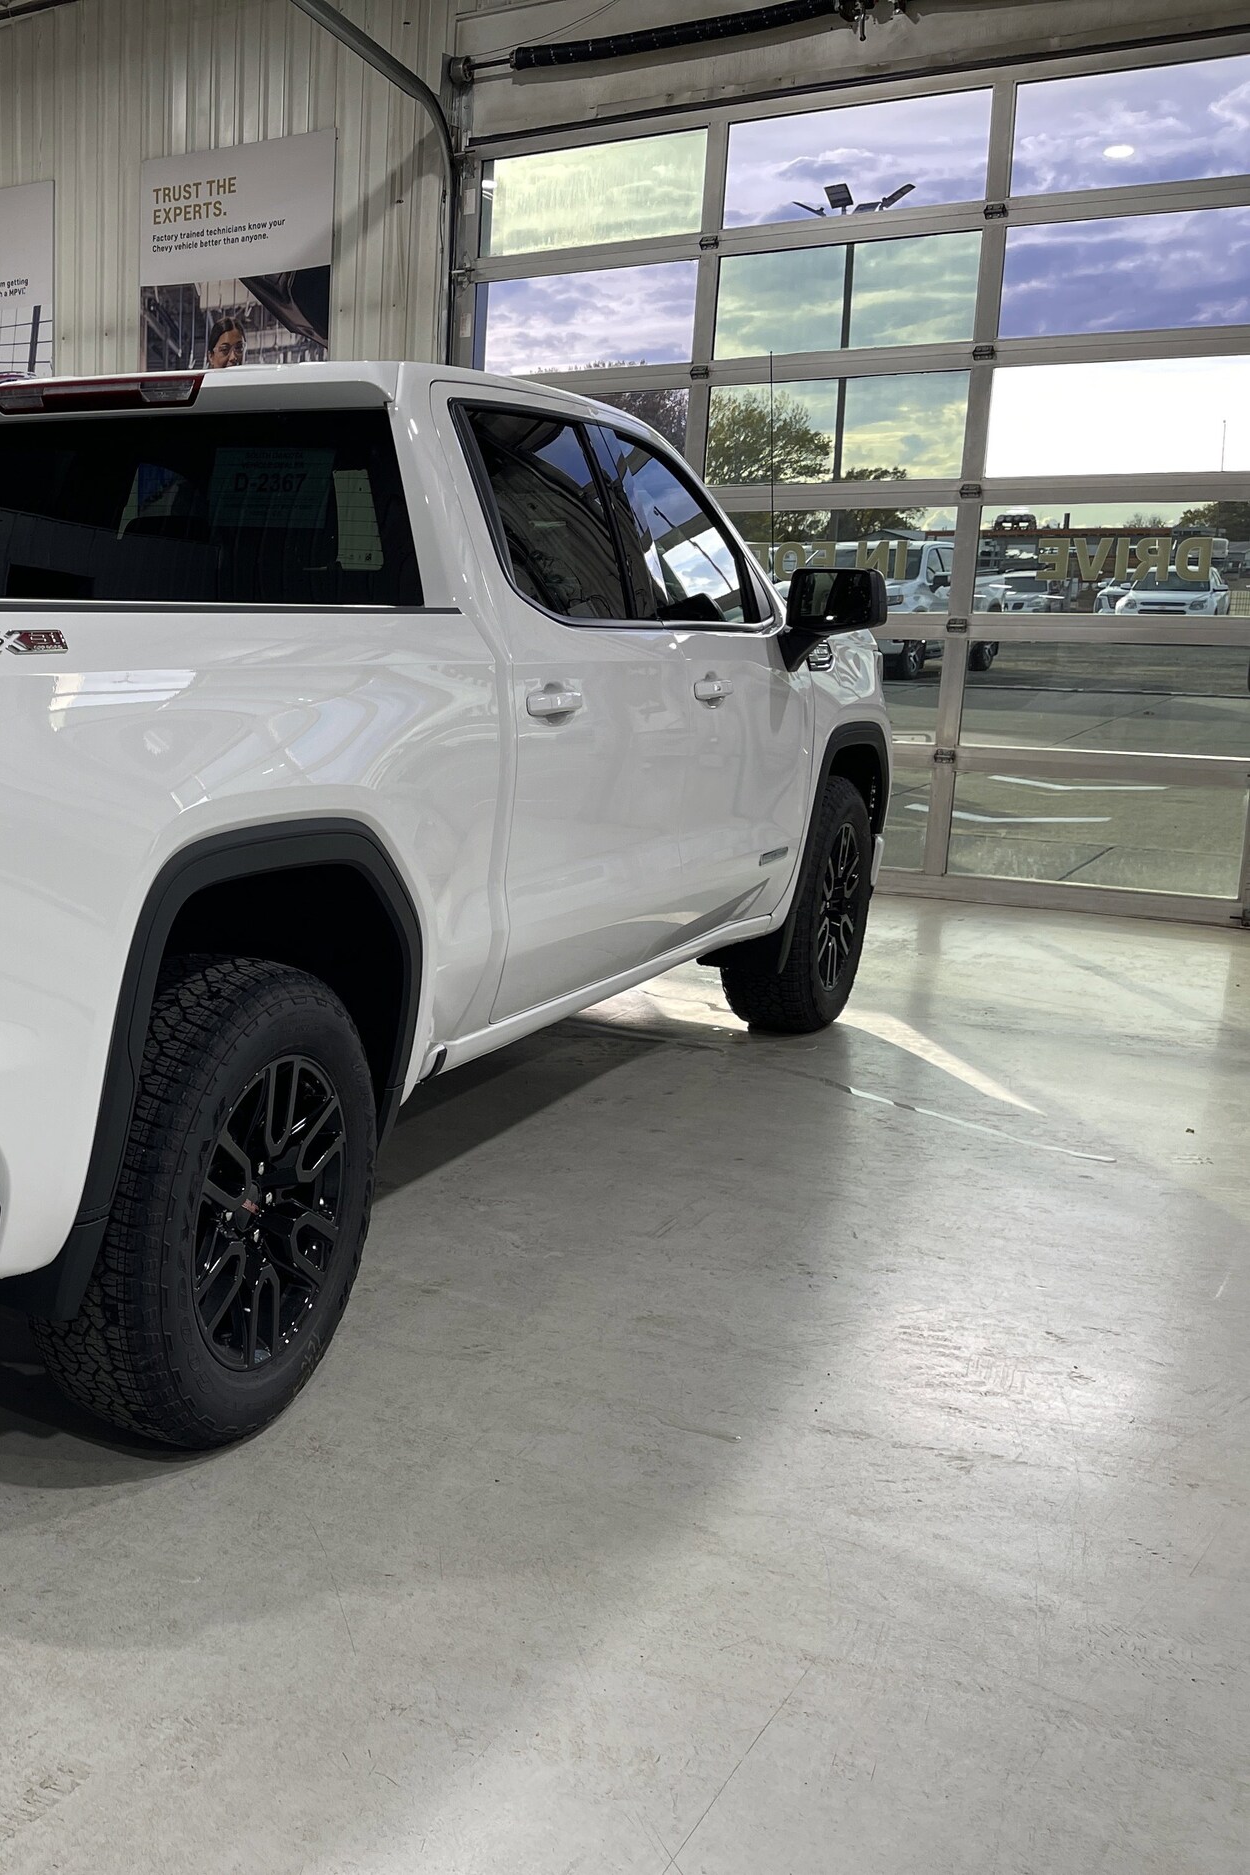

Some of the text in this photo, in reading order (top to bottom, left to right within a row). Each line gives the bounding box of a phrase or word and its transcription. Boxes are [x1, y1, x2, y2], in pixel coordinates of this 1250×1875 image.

[153, 176, 237, 204] TRUST THE
[153, 200, 227, 225] EXPERTS.
[152, 219, 285, 242] Factory trained technicians know your
[152, 233, 268, 253] Chevy vehicle better than anyone.
[6, 278, 28, 289] getting
[234, 472, 307, 492] D-2367
